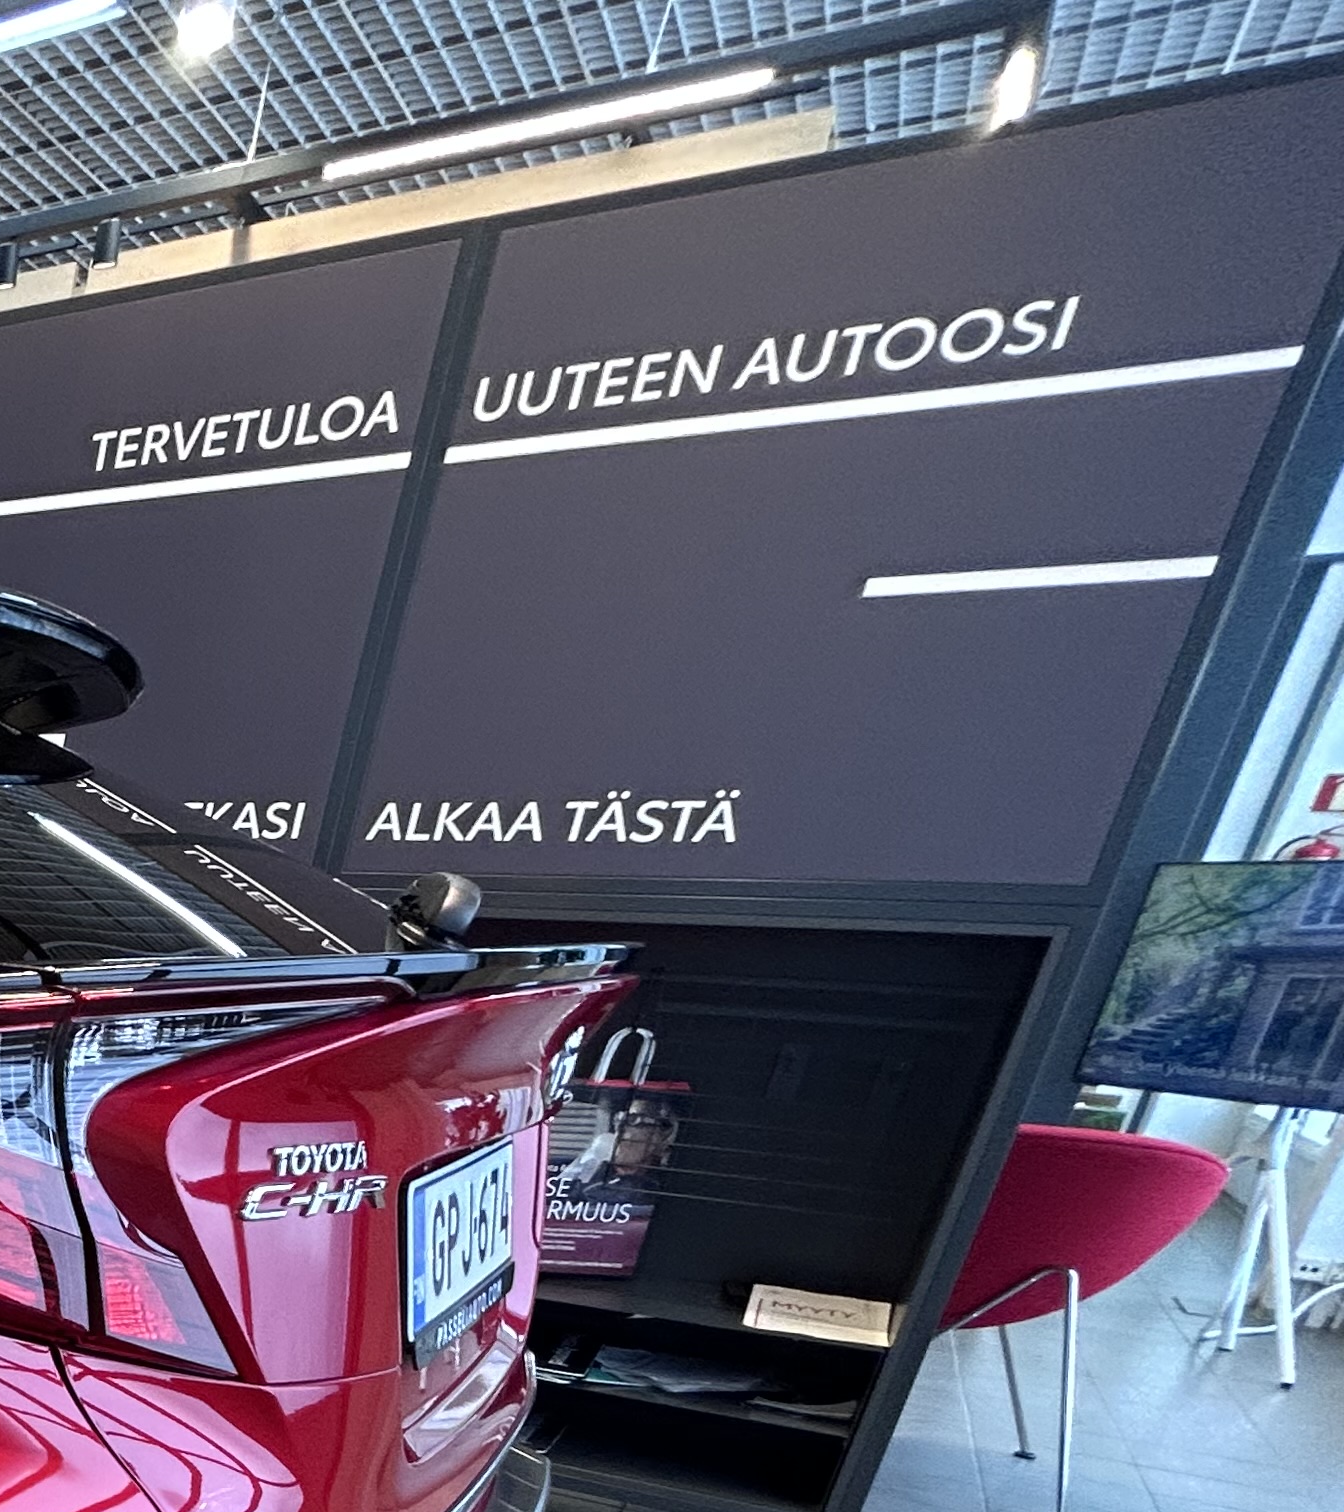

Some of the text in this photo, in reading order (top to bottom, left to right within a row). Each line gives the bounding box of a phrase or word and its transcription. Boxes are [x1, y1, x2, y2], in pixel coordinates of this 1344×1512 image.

[92, 294, 1082, 472] TERVETULOA UUTEEN AUTOOSI
[365, 801, 544, 843] ALKAA
[563, 789, 743, 844] TÄSTÄ
[272, 1139, 368, 1178] TOYOTA
[238, 1173, 388, 1222] C-HR
[431, 1162, 510, 1298] GPJ-674
